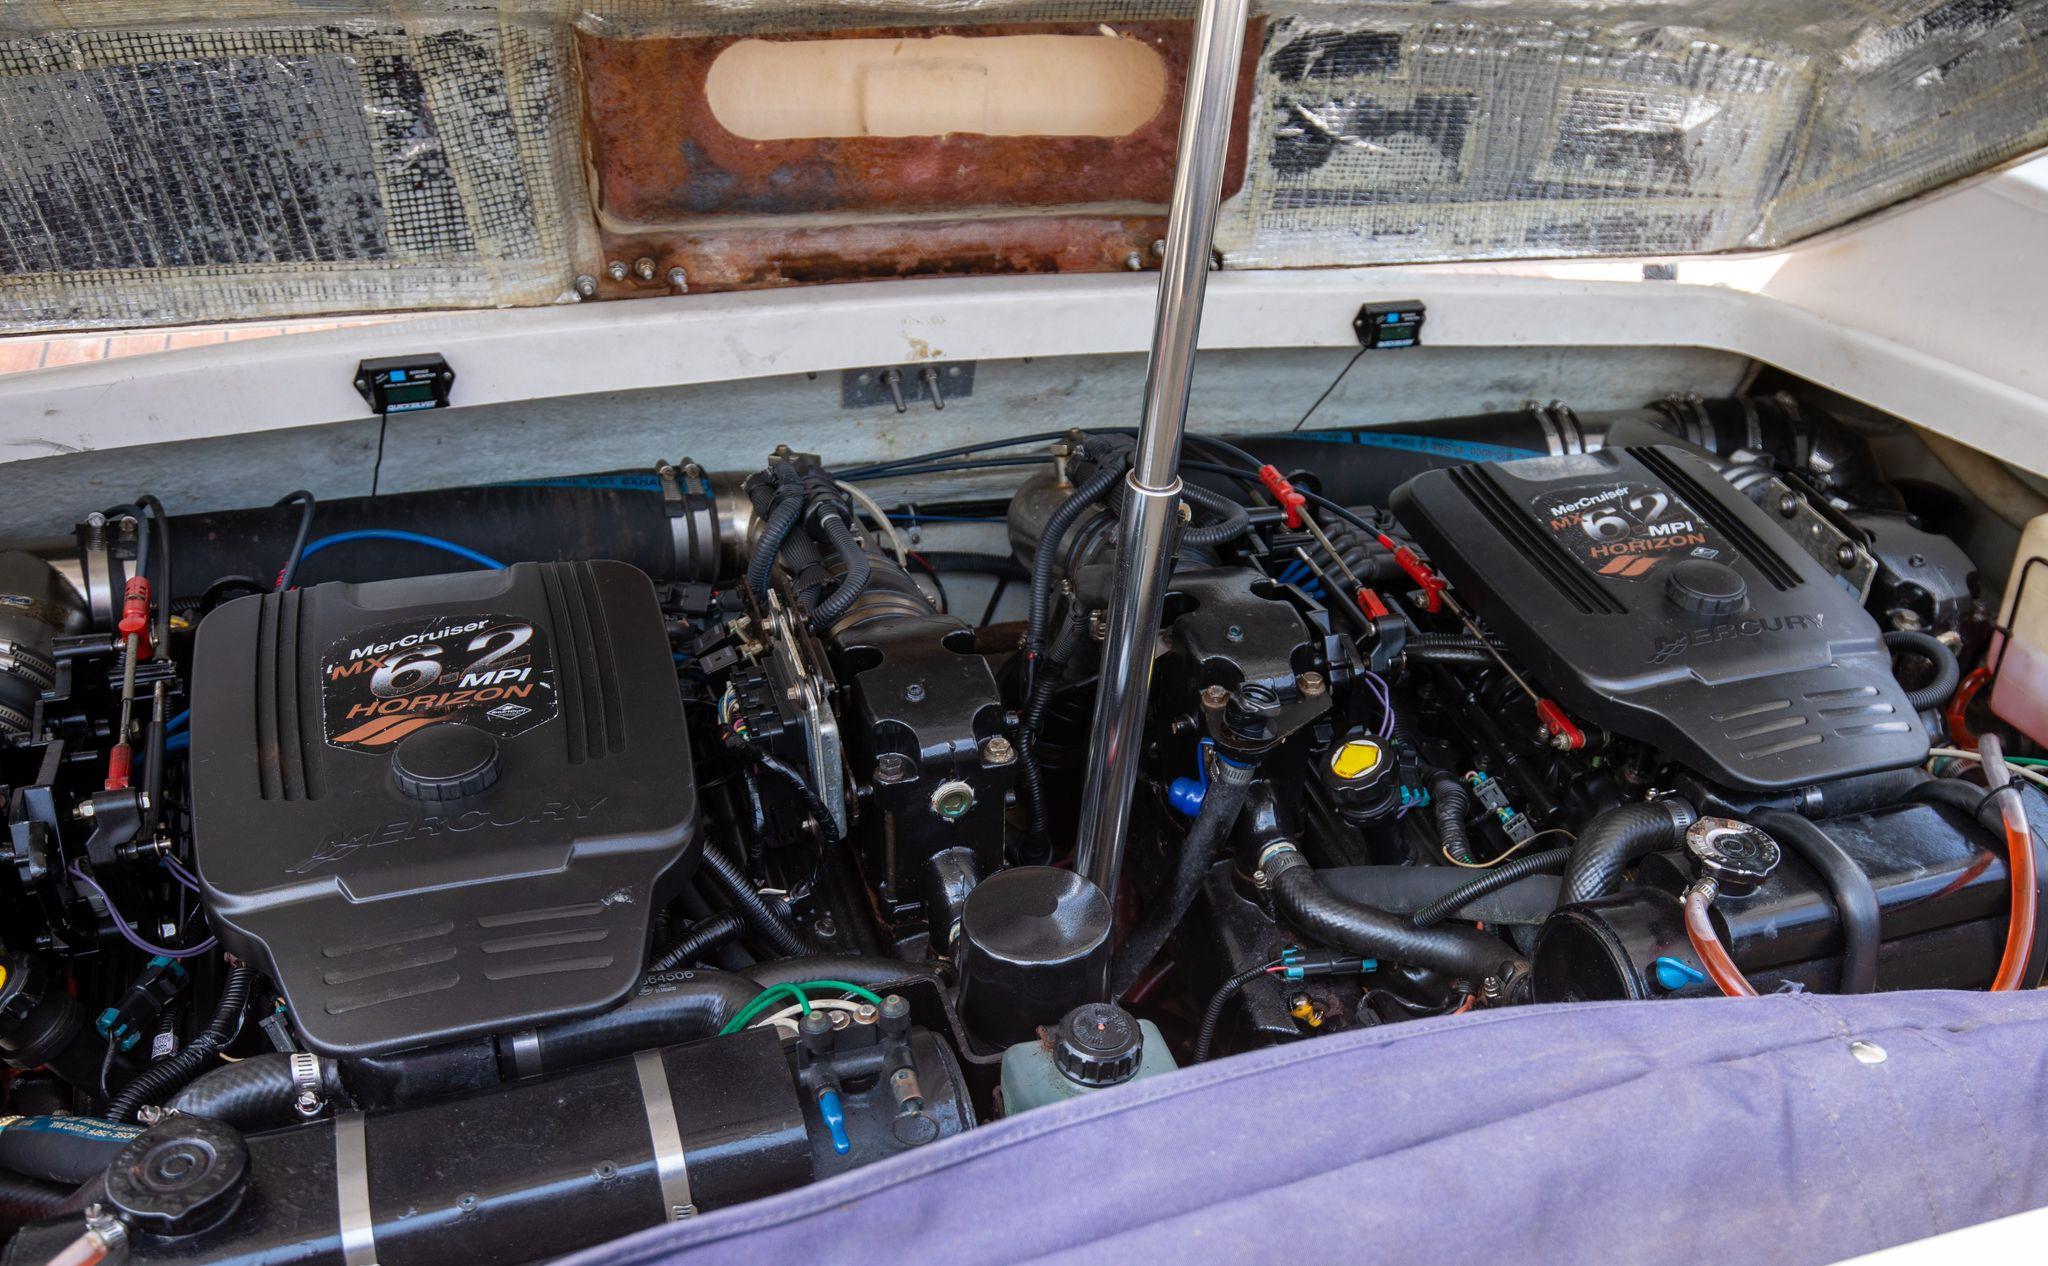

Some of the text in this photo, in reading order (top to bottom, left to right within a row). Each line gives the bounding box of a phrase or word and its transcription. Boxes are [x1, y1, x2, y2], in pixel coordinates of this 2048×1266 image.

[387, 400, 437, 412] QUICKSILVER
[1549, 485, 1629, 517] MerCruiser
[1551, 511, 1583, 532] MX
[1649, 520, 1693, 537] MPI
[1590, 532, 1706, 559] HORIZON
[350, 619, 489, 661] MerCruiser
[1645, 613, 1824, 664] MERCURY
[331, 654, 389, 681] MX
[458, 667, 532, 687] MPI
[346, 684, 534, 719] HORIZON
[285, 797, 607, 873] MERCURY
